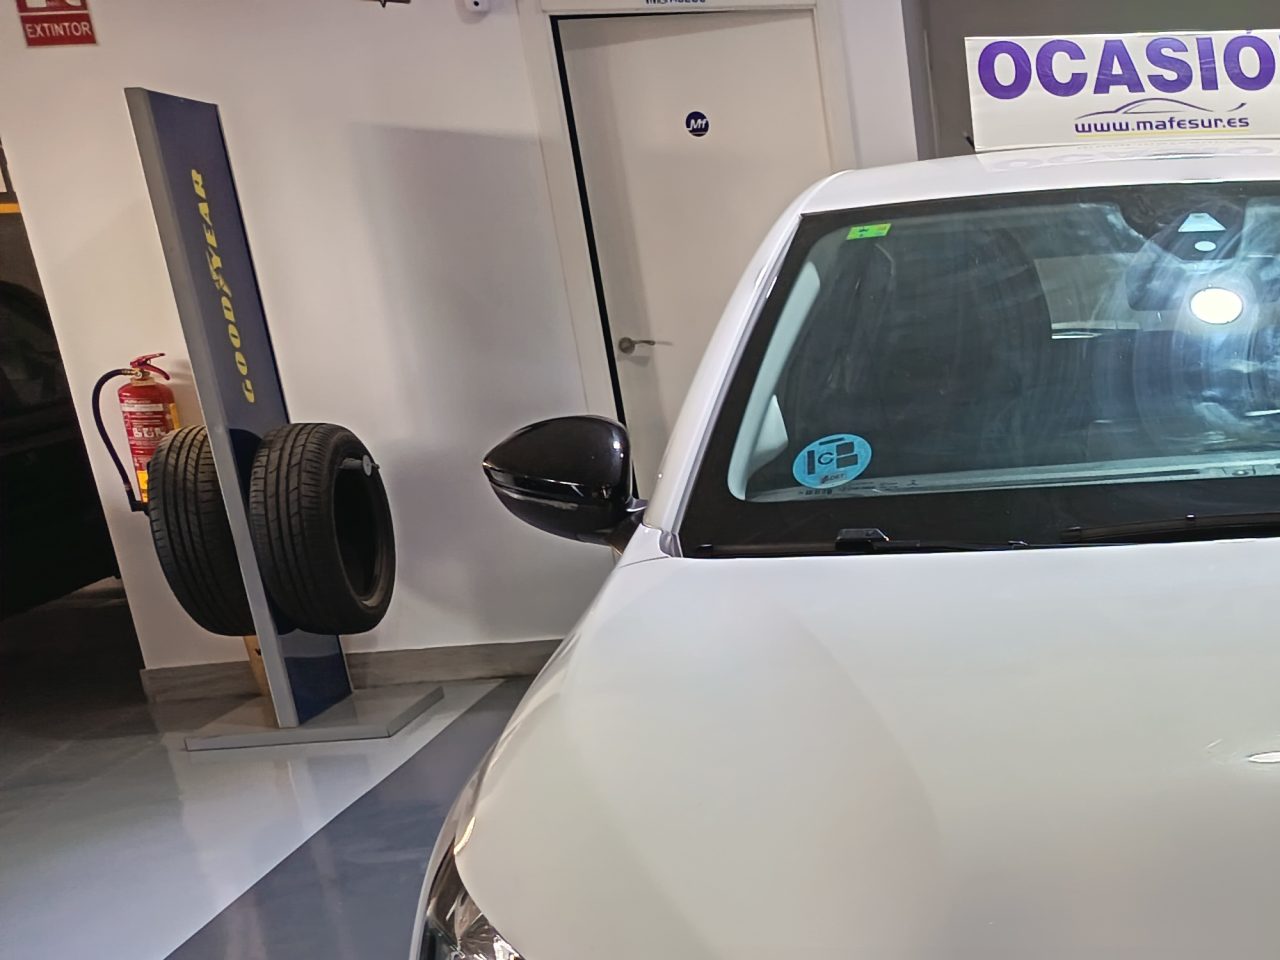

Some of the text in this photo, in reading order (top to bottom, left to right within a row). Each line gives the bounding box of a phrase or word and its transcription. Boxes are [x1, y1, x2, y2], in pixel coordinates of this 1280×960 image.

[25, 21, 92, 38] EXTINTOR
[1074, 116, 1250, 134] www.mafesur.es
[191, 169, 255, 403] GOODYEAR
